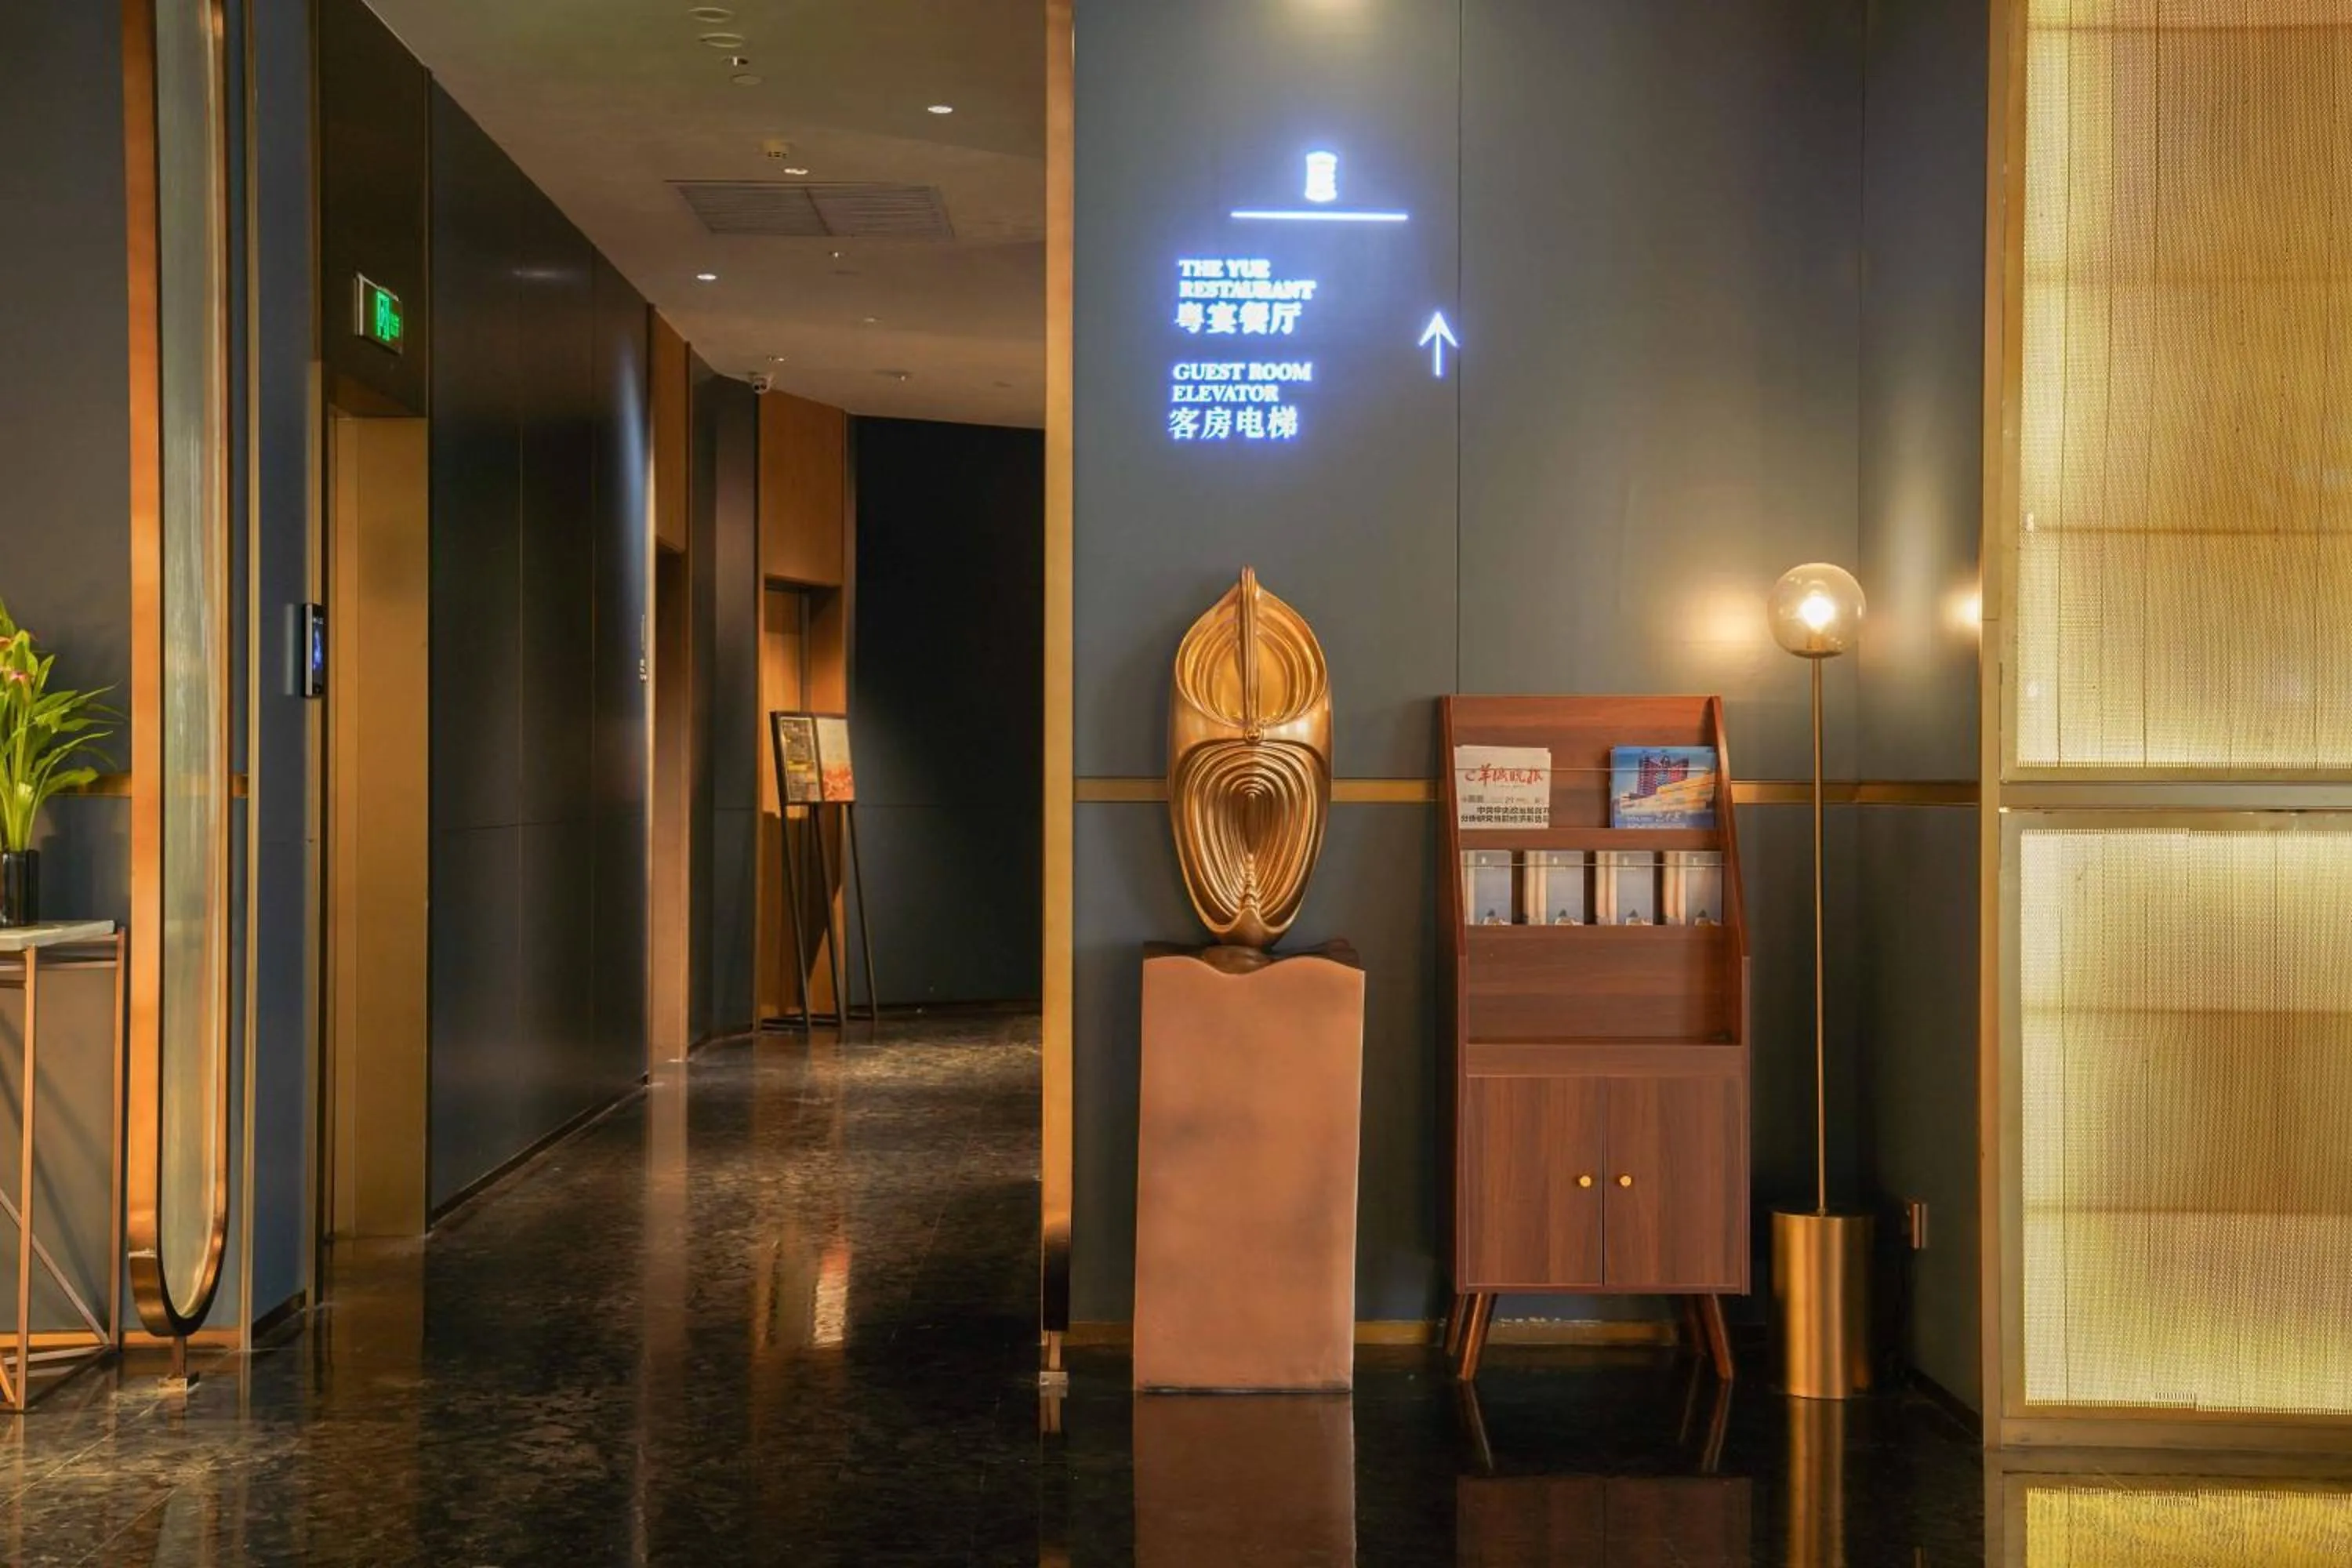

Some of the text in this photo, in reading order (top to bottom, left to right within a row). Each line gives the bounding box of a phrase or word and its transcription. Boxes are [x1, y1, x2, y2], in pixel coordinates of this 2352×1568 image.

[1178, 260, 1270, 277] THE YUE
[1178, 280, 1316, 299] RESTAURANT
[1173, 363, 1312, 381] GUEST ROOM
[1172, 385, 1279, 402] ELEVATOR
[1168, 405, 1298, 439] 客房电梯
